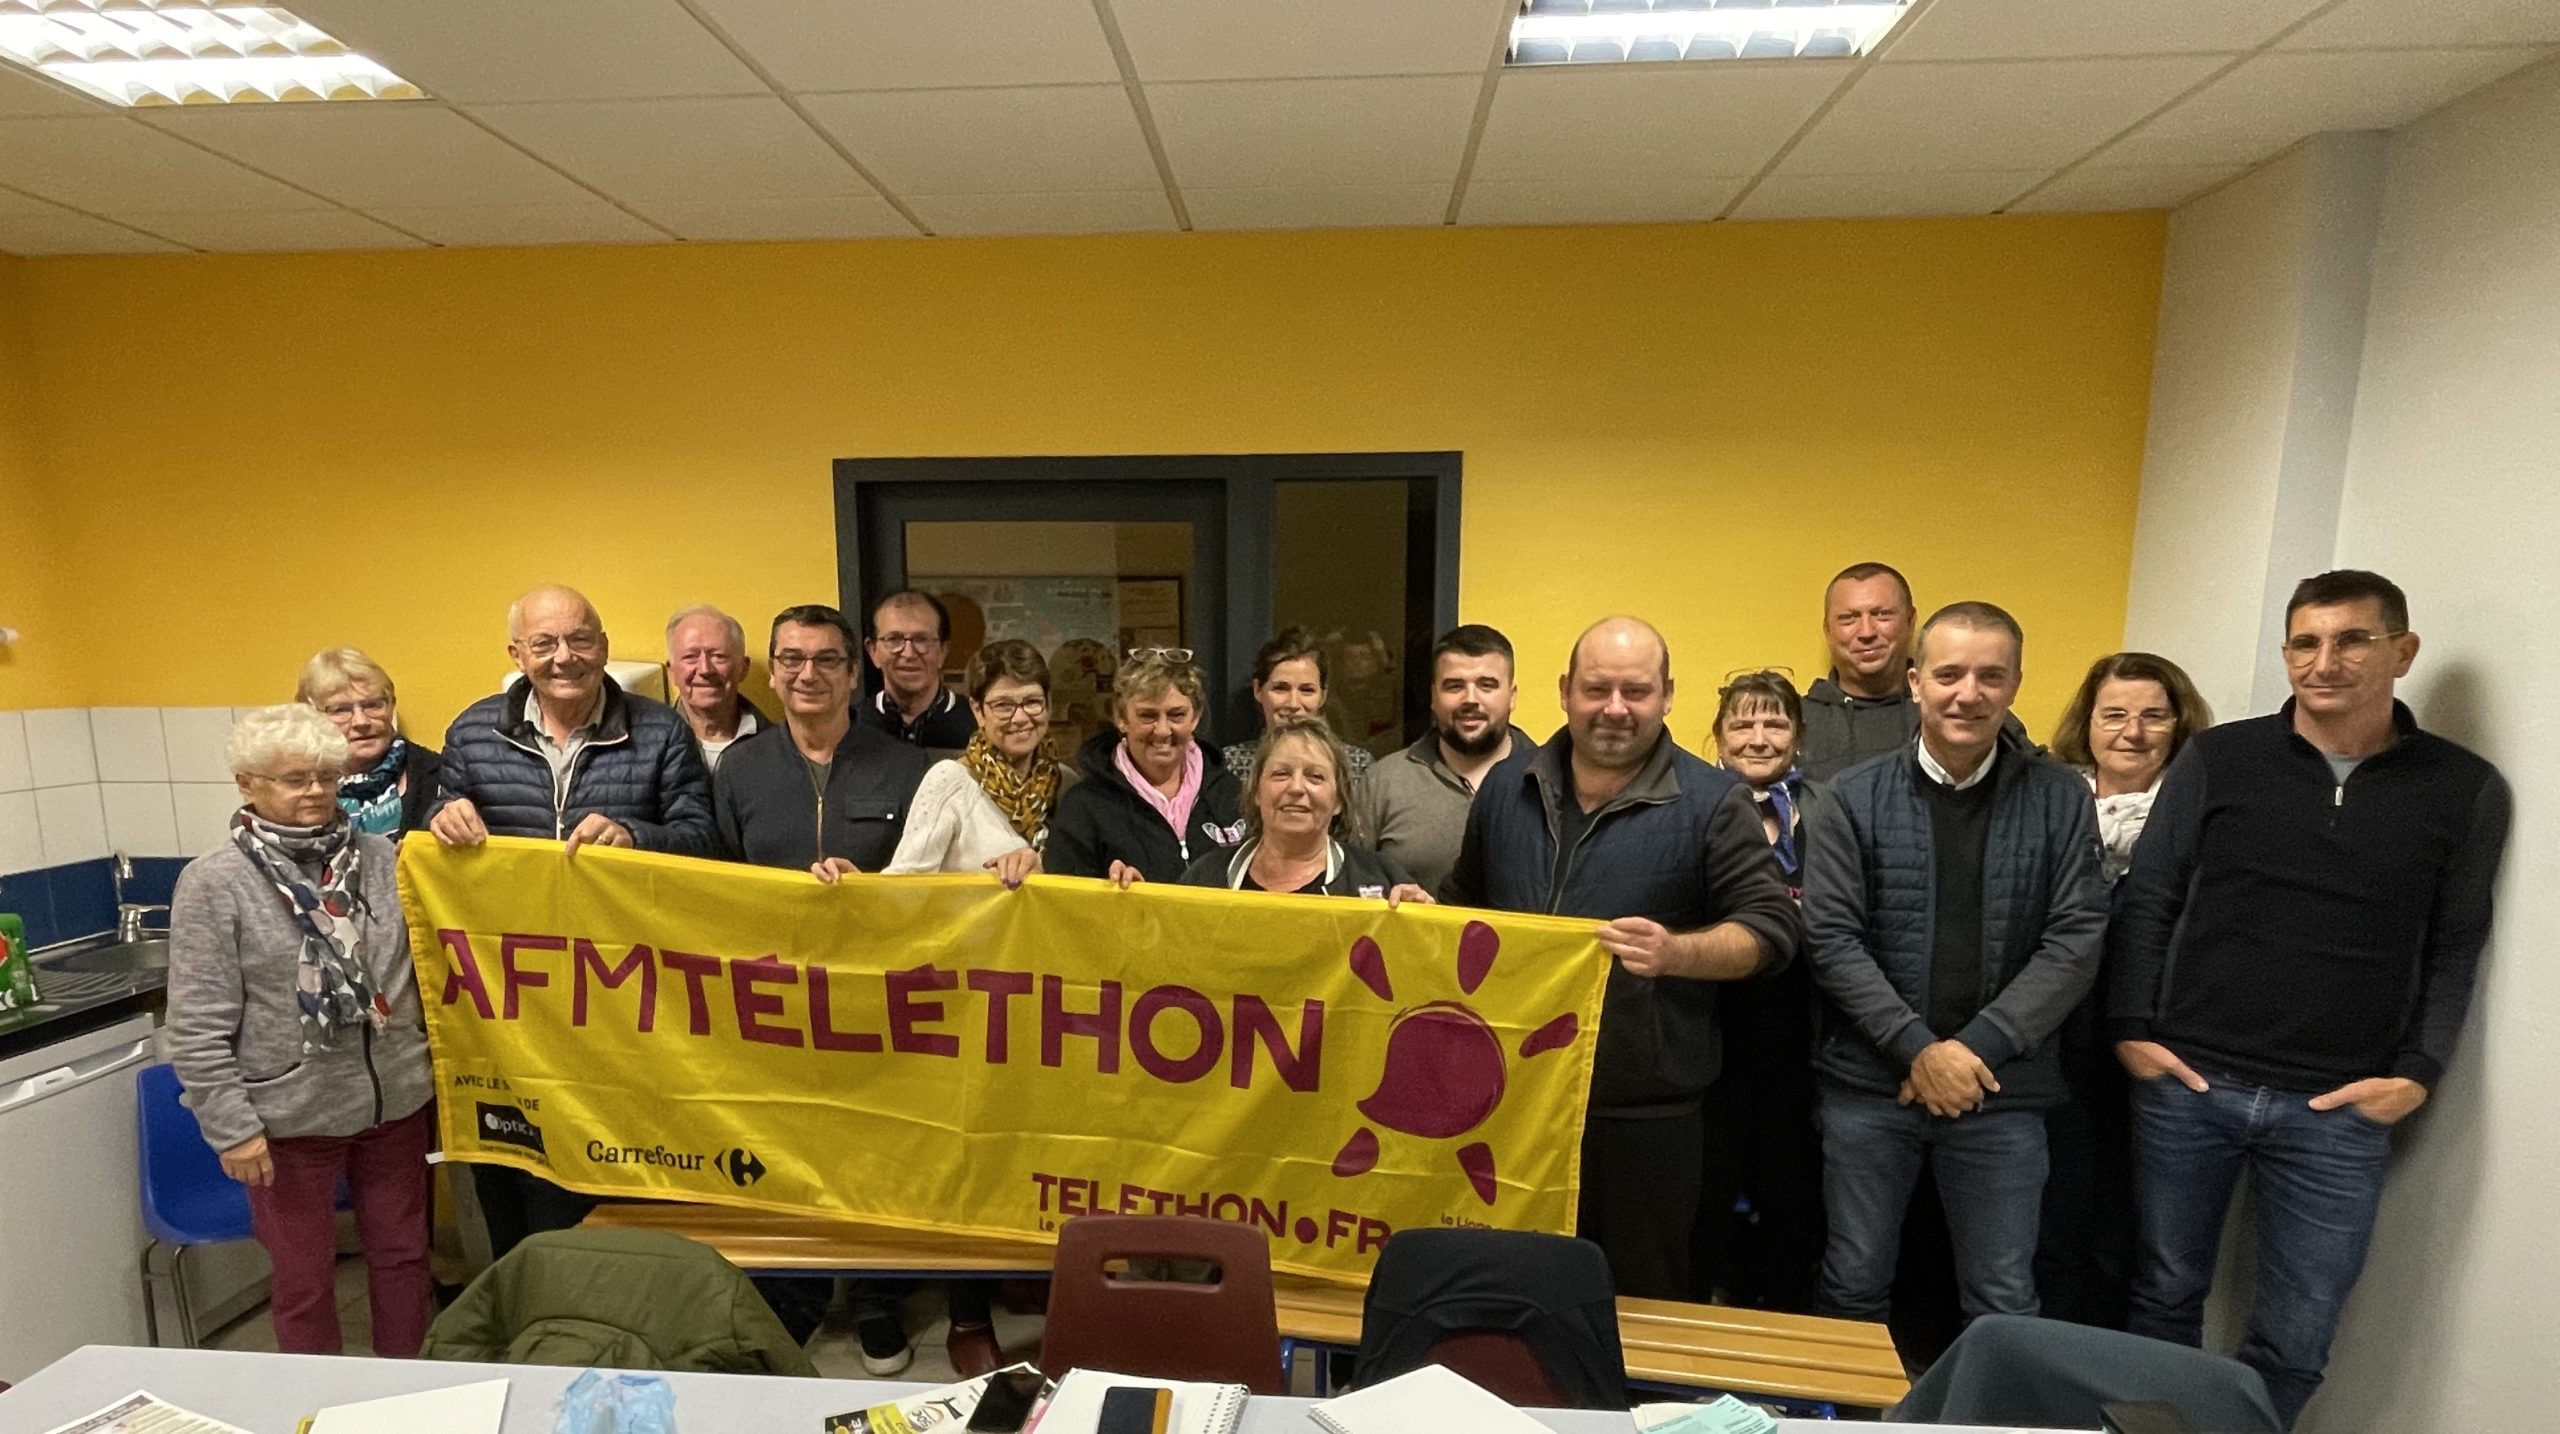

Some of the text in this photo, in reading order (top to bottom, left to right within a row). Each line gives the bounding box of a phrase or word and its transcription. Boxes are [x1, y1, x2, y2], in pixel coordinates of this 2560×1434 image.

[454, 1074, 484, 1088] AVEC
[487, 1077, 499, 1090] LE
[524, 1098, 540, 1111] DE
[586, 1139, 706, 1171] Carrefour
